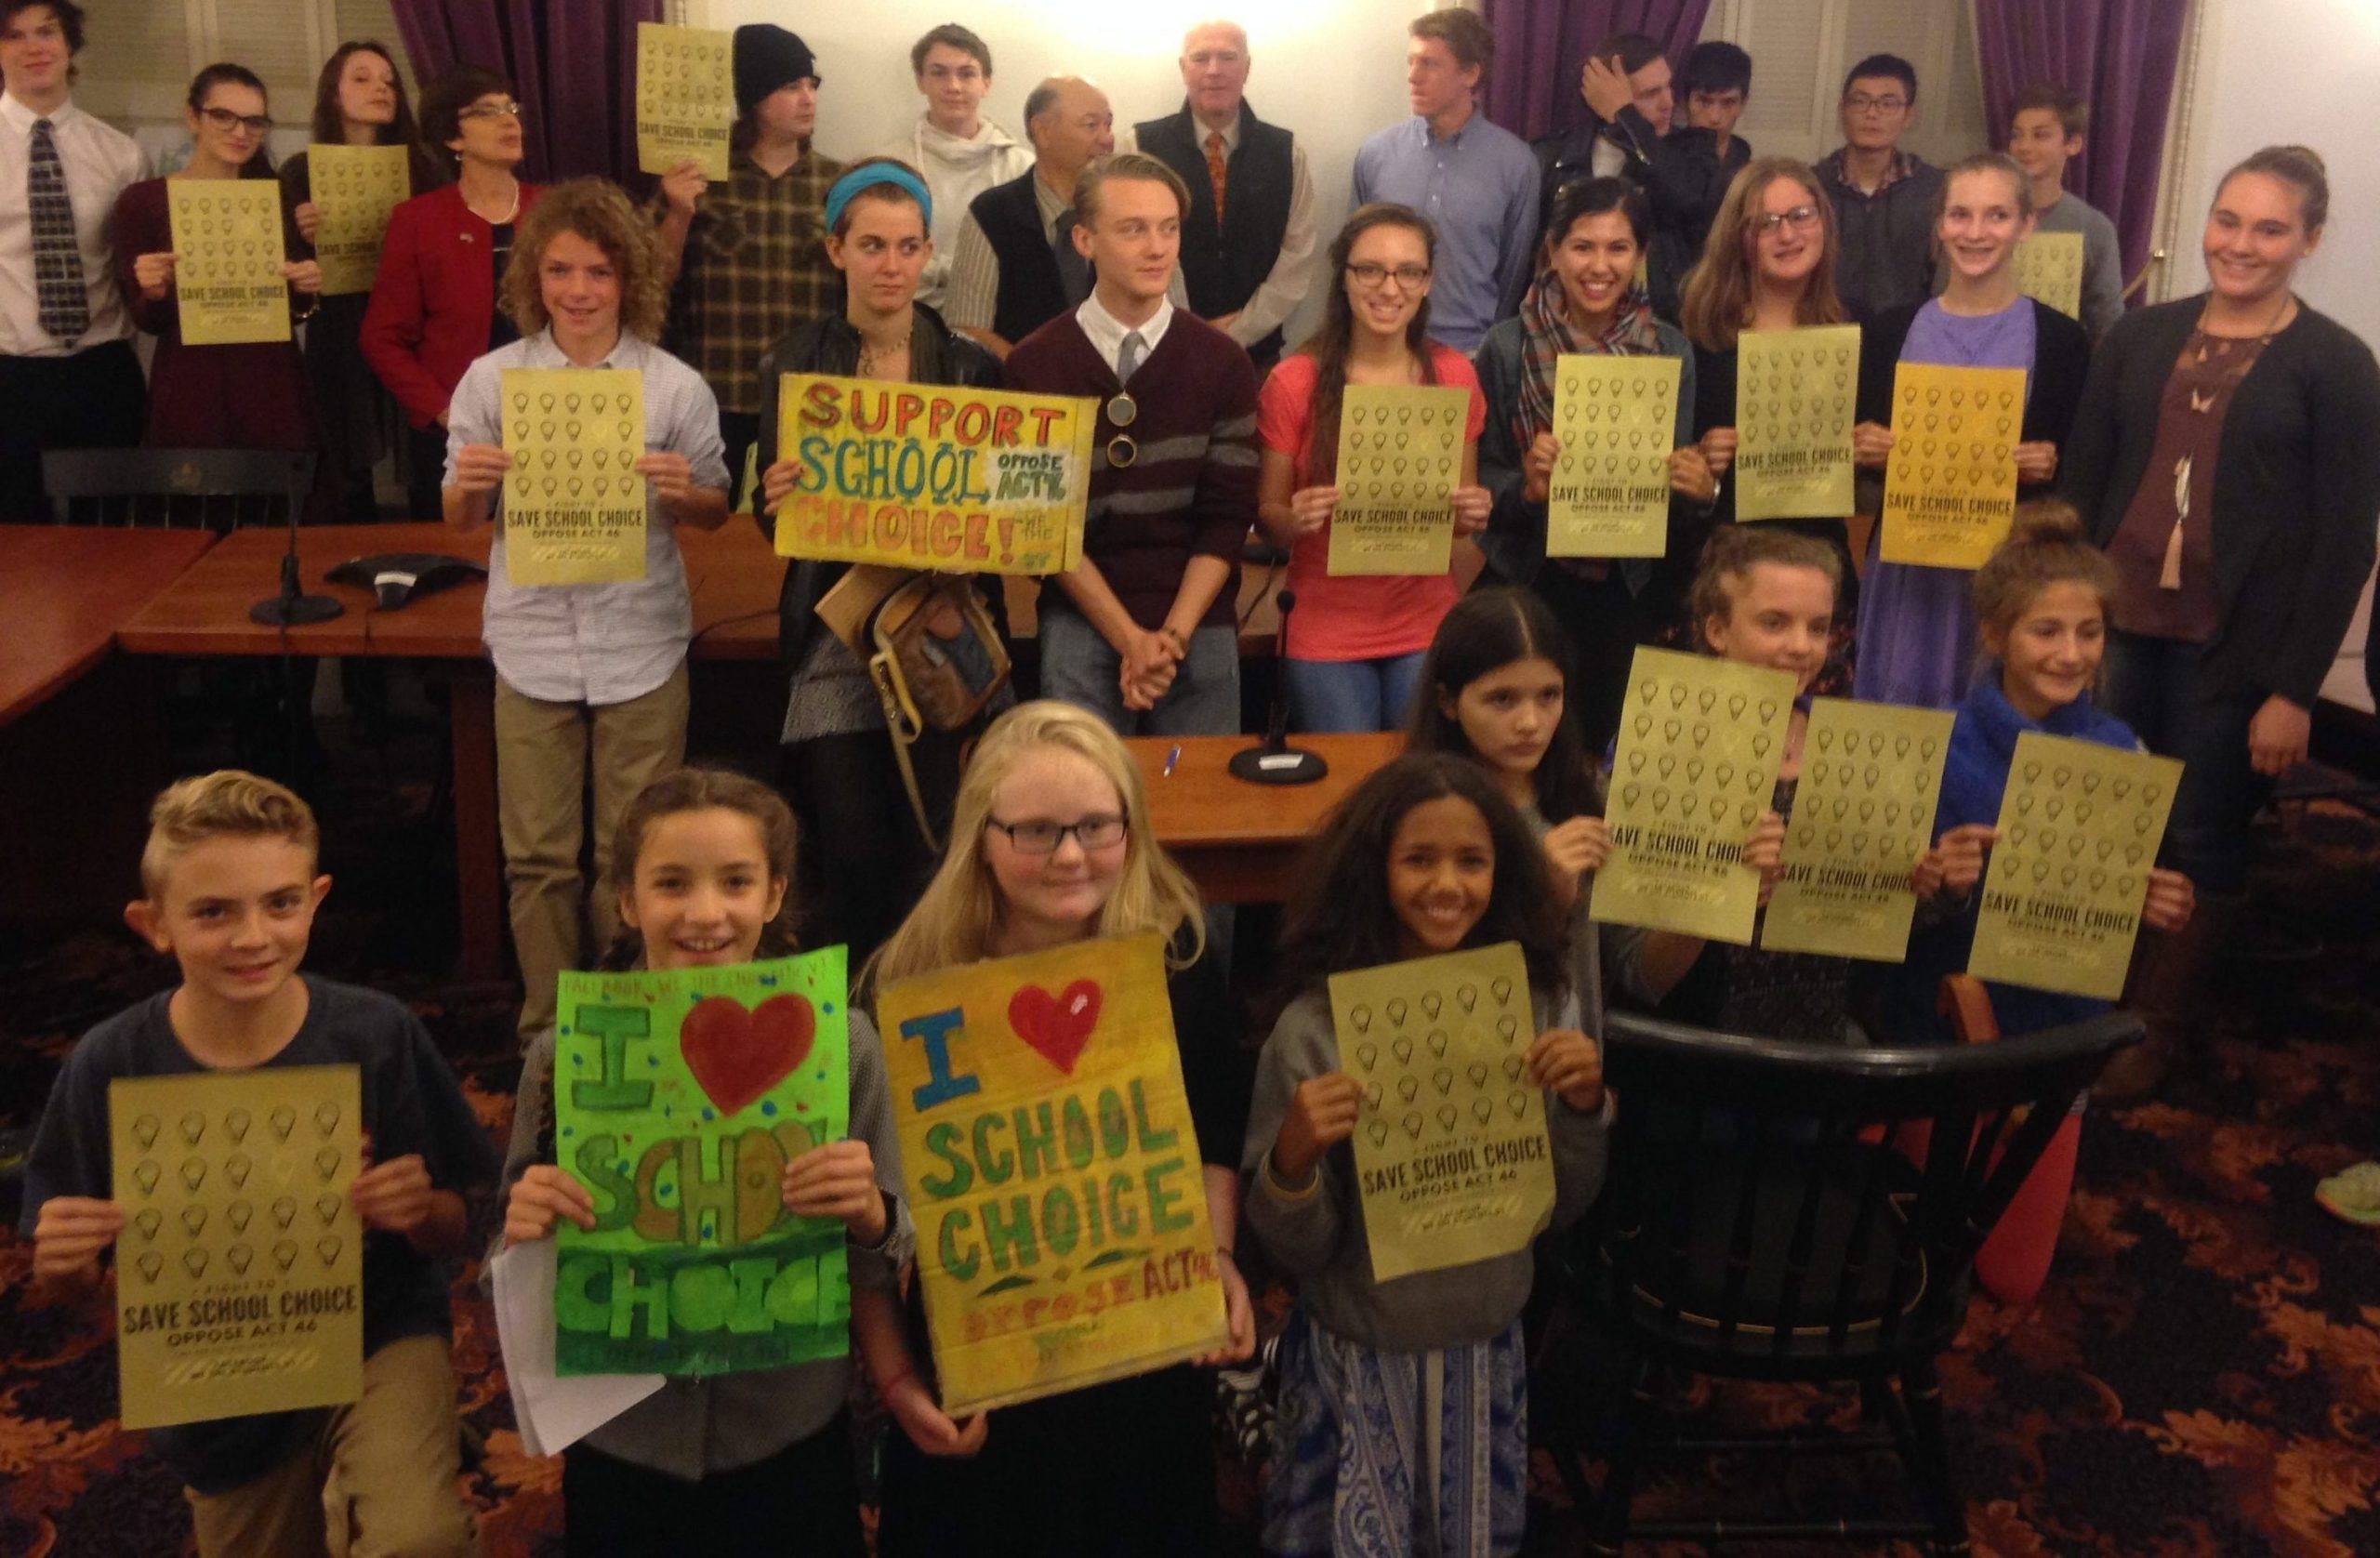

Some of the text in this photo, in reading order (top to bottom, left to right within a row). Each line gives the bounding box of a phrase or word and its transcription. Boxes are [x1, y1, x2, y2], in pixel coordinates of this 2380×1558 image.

[799, 382, 1066, 447] SUPPORT
[798, 435, 991, 505] SCHOOL
[998, 453, 1063, 471] OPPOSE
[1738, 447, 1849, 470] SAVE SCHOOL CHOICE
[1552, 486, 1666, 503] SAVE SCHOOL CHOICE
[1886, 493, 2011, 517] SAVE SCHOOL CHOICE
[508, 509, 642, 528] SAVE SCHOOL CHOICE
[532, 530, 576, 538] OPPOSE
[581, 530, 602, 538] ACT
[796, 495, 1015, 566] CHOICE!
[1334, 509, 1451, 524] SAVE SCHOOL CHOICE
[1614, 825, 1641, 848] AVE
[1647, 830, 1699, 856] SCHOOL
[1786, 863, 1812, 883] AVE
[1818, 868, 1867, 888] SCHOOL
[1983, 890, 2019, 913] SAVE
[2027, 899, 2079, 922] SCHOOL
[2084, 909, 2135, 933] CHOICE
[572, 1003, 654, 1111] I
[899, 1006, 980, 1113] I
[920, 1076, 1179, 1200] SCHOOL
[575, 1118, 827, 1248] SCHOO
[1363, 1134, 1546, 1196] SAVE SCHOOL CHOICE
[1399, 1180, 1460, 1204] OPPOSE
[1465, 1171, 1493, 1188] ACT
[939, 1156, 1194, 1281] CHOICE
[1144, 1247, 1195, 1300] ACT
[124, 1285, 358, 1334] SAVE SCHOOL CHOICE
[167, 1320, 317, 1347] OPPOSE ACT 46
